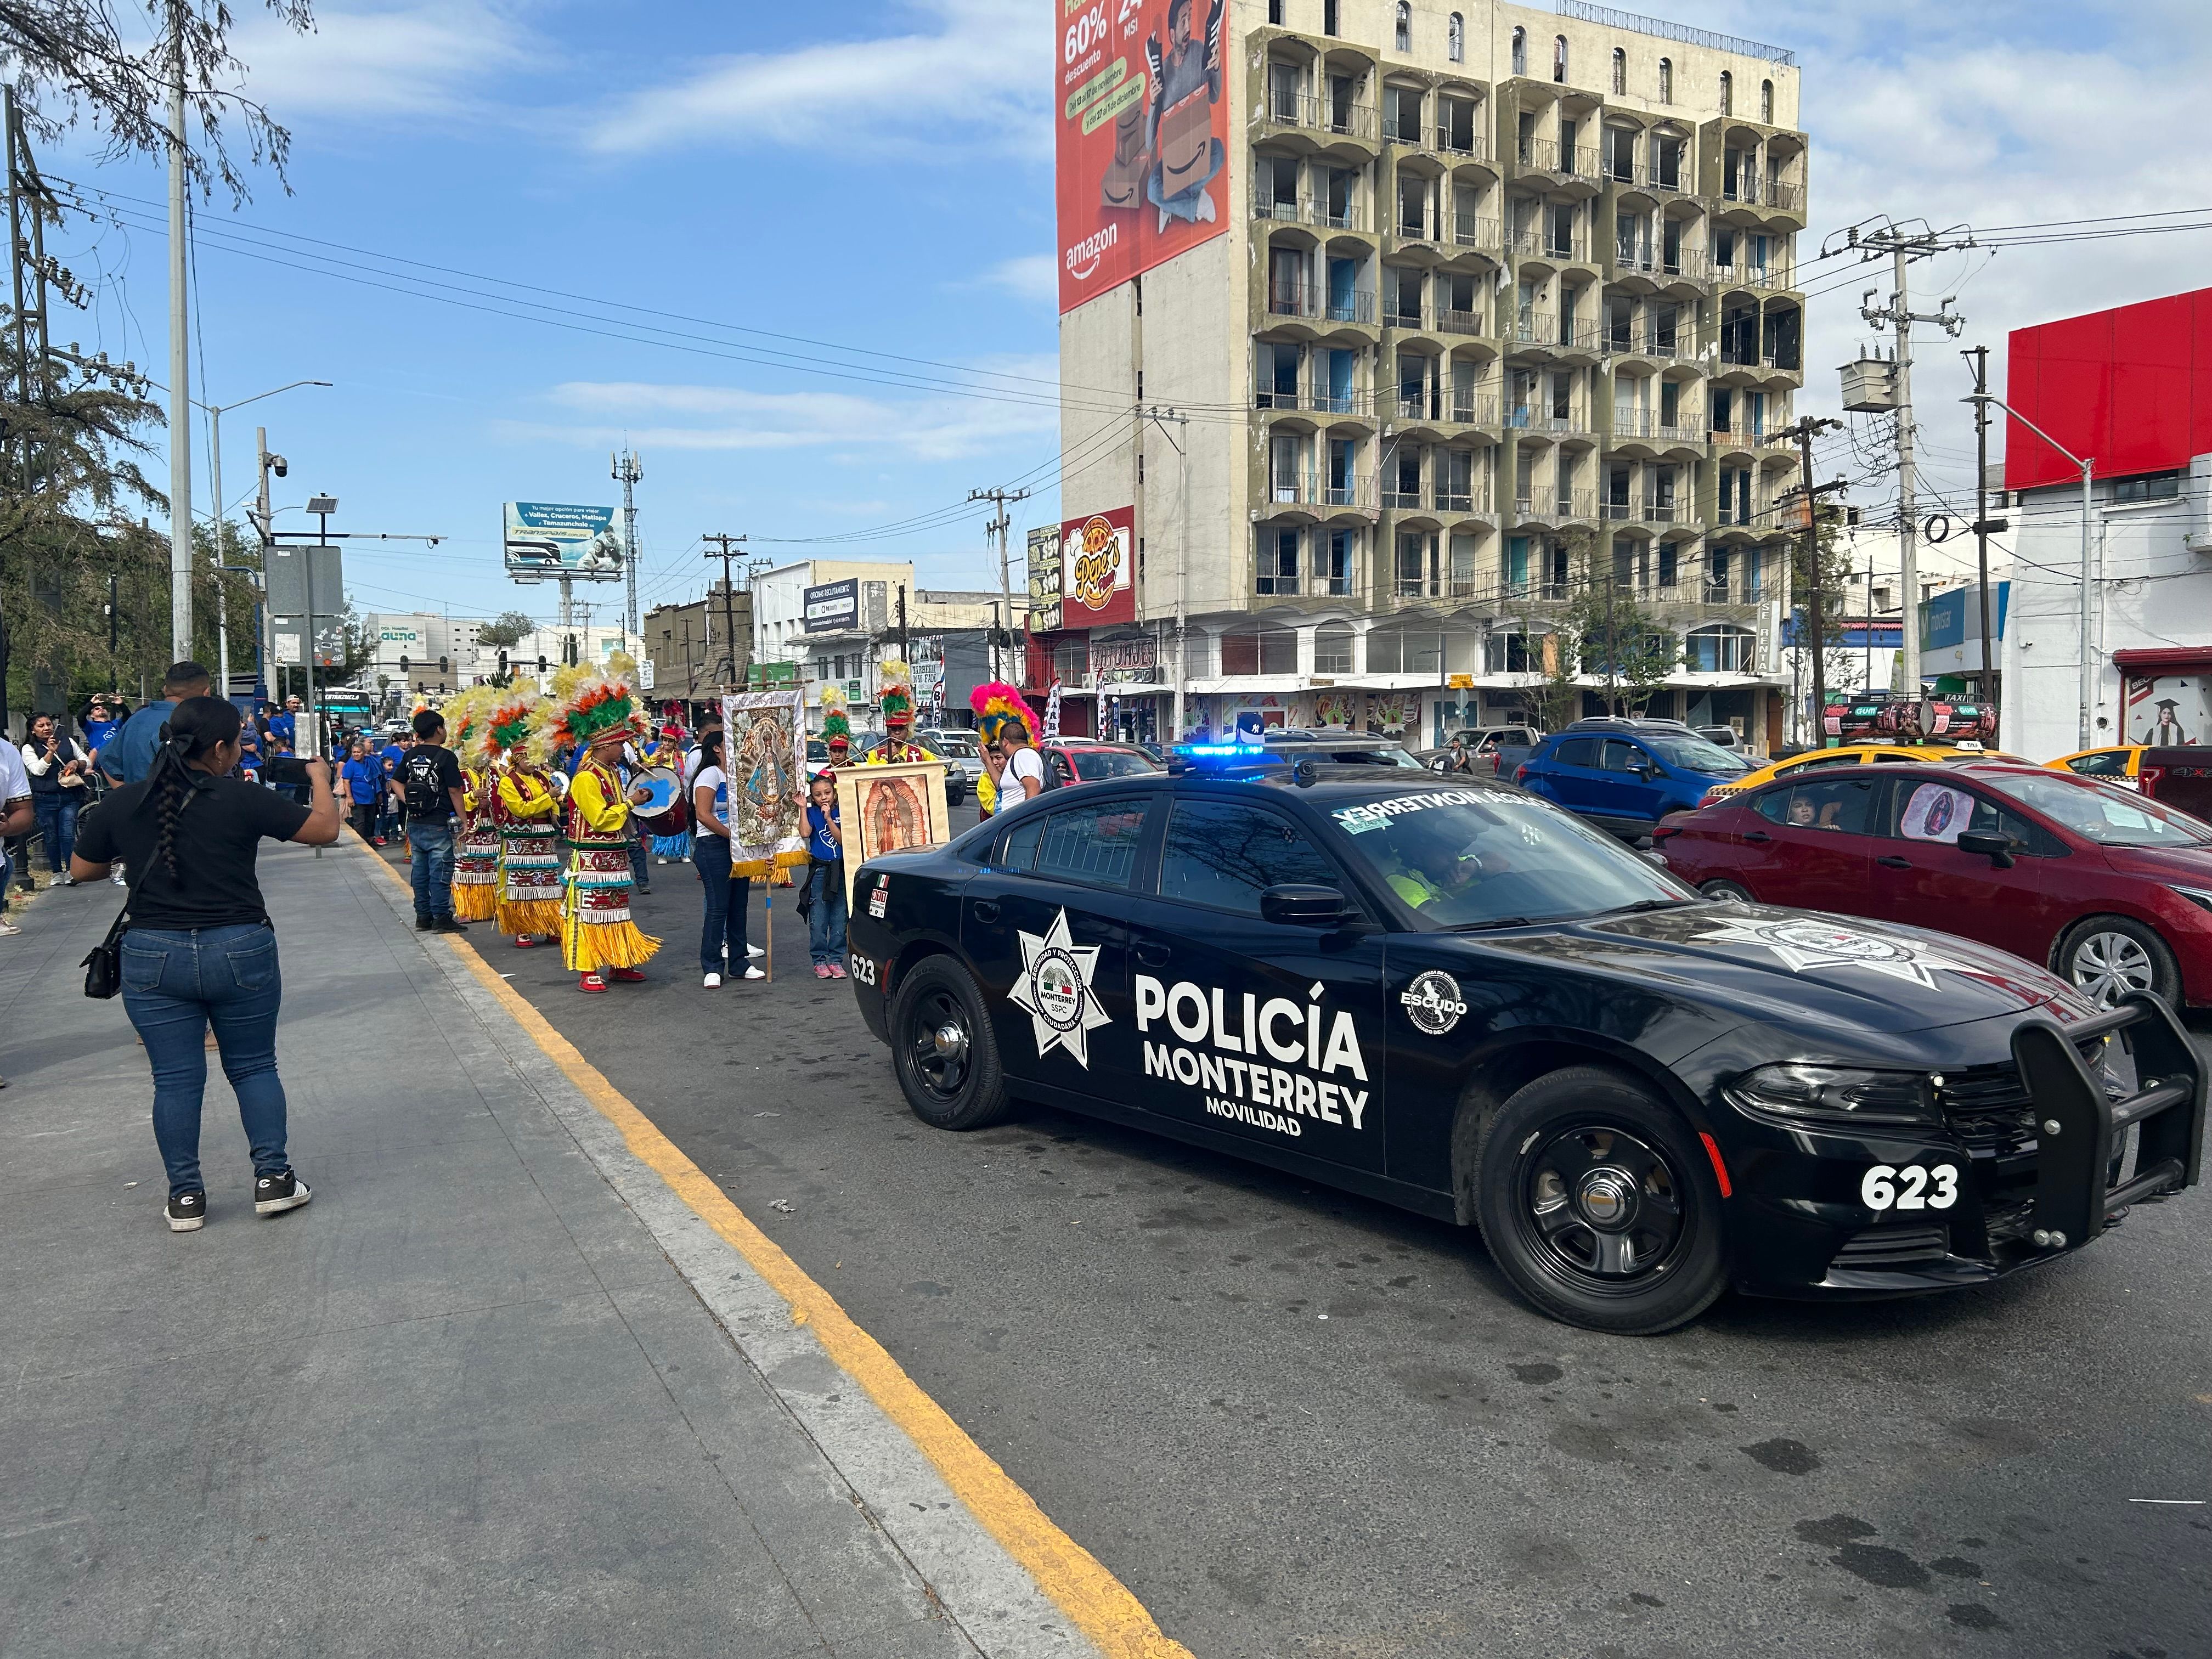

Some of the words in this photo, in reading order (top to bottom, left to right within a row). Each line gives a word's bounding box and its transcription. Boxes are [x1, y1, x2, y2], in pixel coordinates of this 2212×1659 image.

[1065, 0, 1107, 64] 60%
[1124, 17, 1138, 40] MSI
[1065, 50, 1101, 86] descuento
[1077, 95, 1081, 106] 13
[1082, 94, 1086, 103] al
[1087, 88, 1091, 99] 17
[1092, 86, 1097, 95] de
[1098, 67, 1122, 91] noviembre
[1086, 120, 1089, 129] y
[1097, 108, 1102, 120] 27
[1103, 106, 1107, 116] al
[1108, 103, 1110, 112] 1
[1110, 100, 1116, 110] de
[1117, 83, 1141, 106] diciembre
[1065, 222, 1118, 270] amazon
[551, 512, 580, 521] Cruceros,
[1042, 538, 1060, 561] $59
[1042, 572, 1060, 595] $99
[1043, 608, 1060, 631] $129
[1762, 603, 1770, 619] SE
[1931, 609, 1951, 631] movistar
[1093, 640, 1155, 668] TATUAJES
[1758, 628, 1769, 670] RENTA
[924, 674, 936, 683] FADE
[727, 696, 753, 709] DANZA
[1946, 693, 1966, 702] TAXI
[1048, 690, 1058, 737] BARB
[742, 846, 754, 858] LOS
[872, 890, 885, 901] 911
[851, 953, 876, 986] 623
[1031, 950, 1052, 981] SEGURIDAD
[1057, 950, 1082, 991] PROTECCIÓN
[1041, 991, 1076, 1005] MONTERREY
[1408, 970, 1437, 992] ESTRATEGIA
[1444, 973, 1462, 1001] SEGURIDAD
[1051, 1003, 1067, 1014] SSPC
[1401, 992, 1467, 1014] ESCUDO
[1043, 1014, 1076, 1030] CIUDADANA
[1136, 980, 1369, 1082] POLICÍA
[1407, 1007, 1412, 1016] AL
[1410, 1015, 1434, 1035] CUIDADO
[1444, 1014, 1460, 1032] ORDEN
[1144, 1040, 1369, 1131] MONTERREY
[1206, 1096, 1302, 1137] MOVILIDAD
[1861, 1163, 1959, 1210] 623
